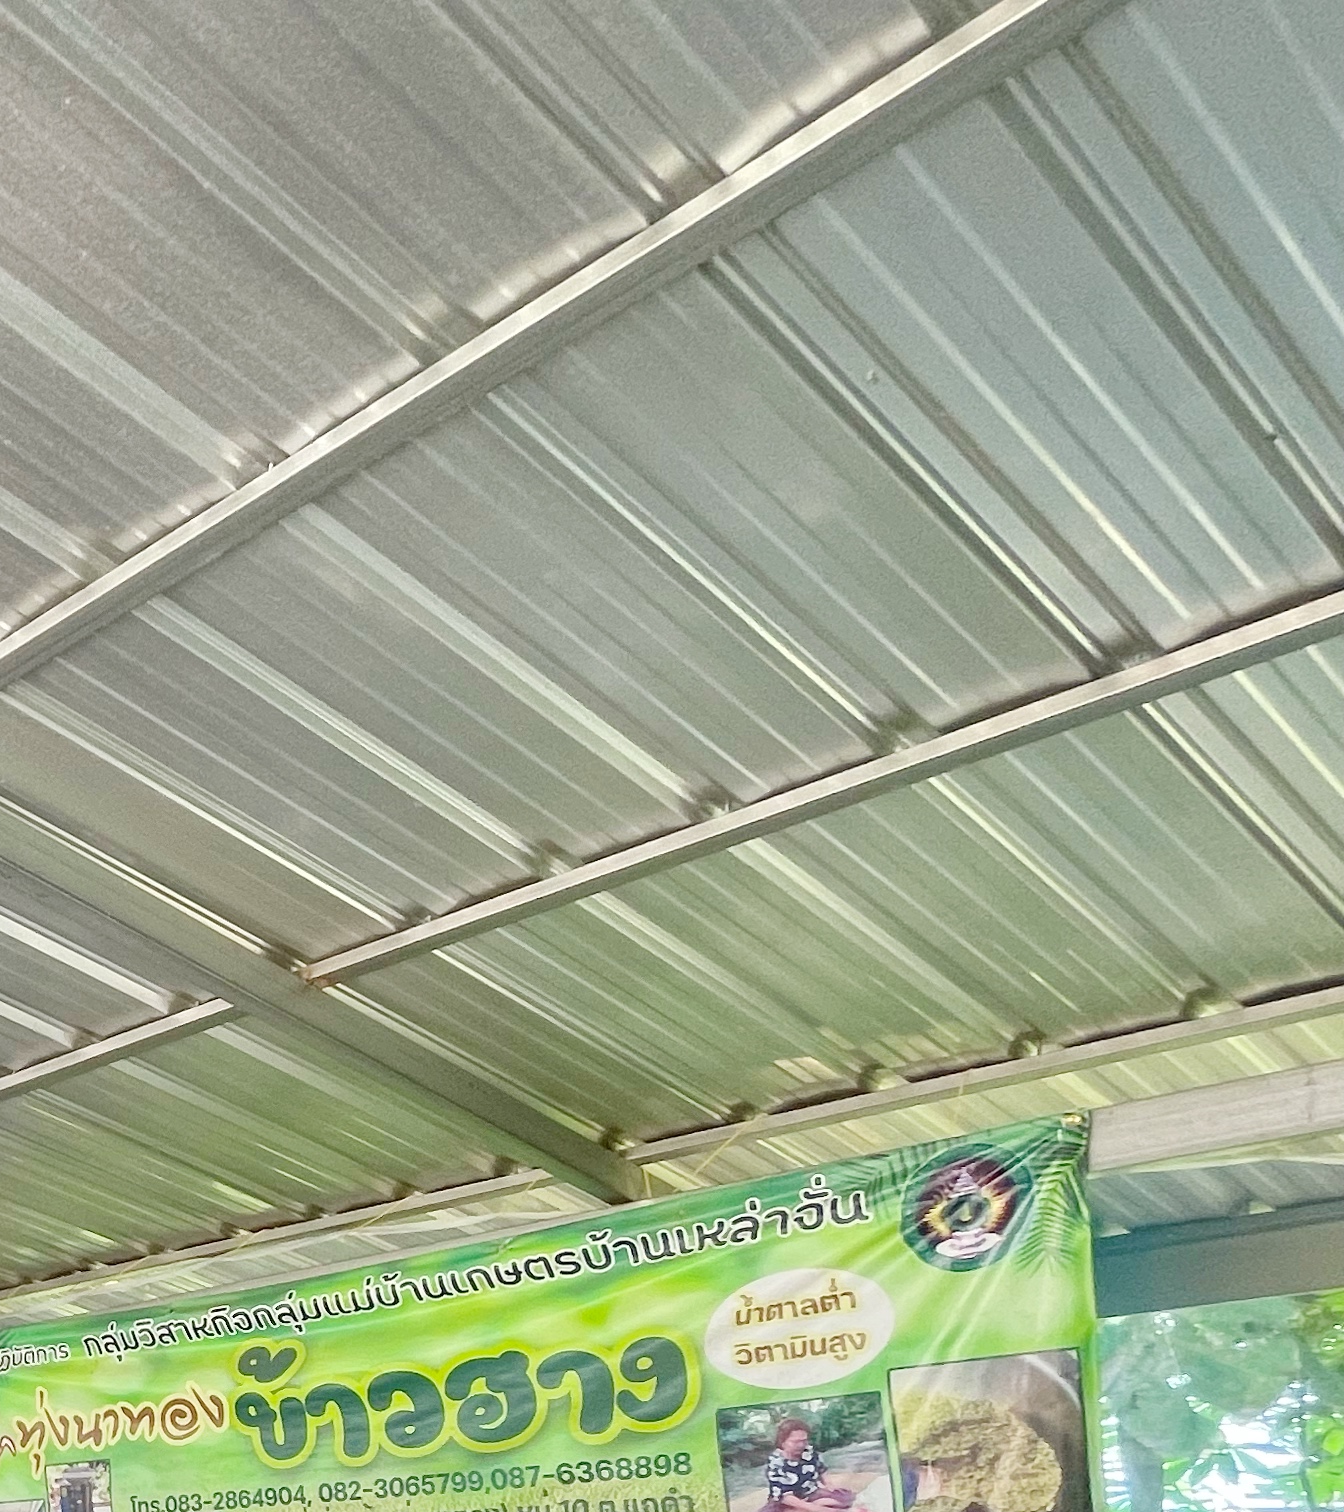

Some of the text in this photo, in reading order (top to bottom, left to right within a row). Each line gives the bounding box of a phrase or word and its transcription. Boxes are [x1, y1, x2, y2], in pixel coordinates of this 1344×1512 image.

[83, 1174, 869, 1361] กลุ่มวิสาหกิจกลุ่มแม่บ้านเกษตรบ้านเหล่าจั่น
[736, 1278, 856, 1326] น้ำตาลต่ำ
[736, 1330, 867, 1365] วิตามินสูง
[18, 1337, 687, 1470] ทุ่งนาทอง ข้าวฮาง
